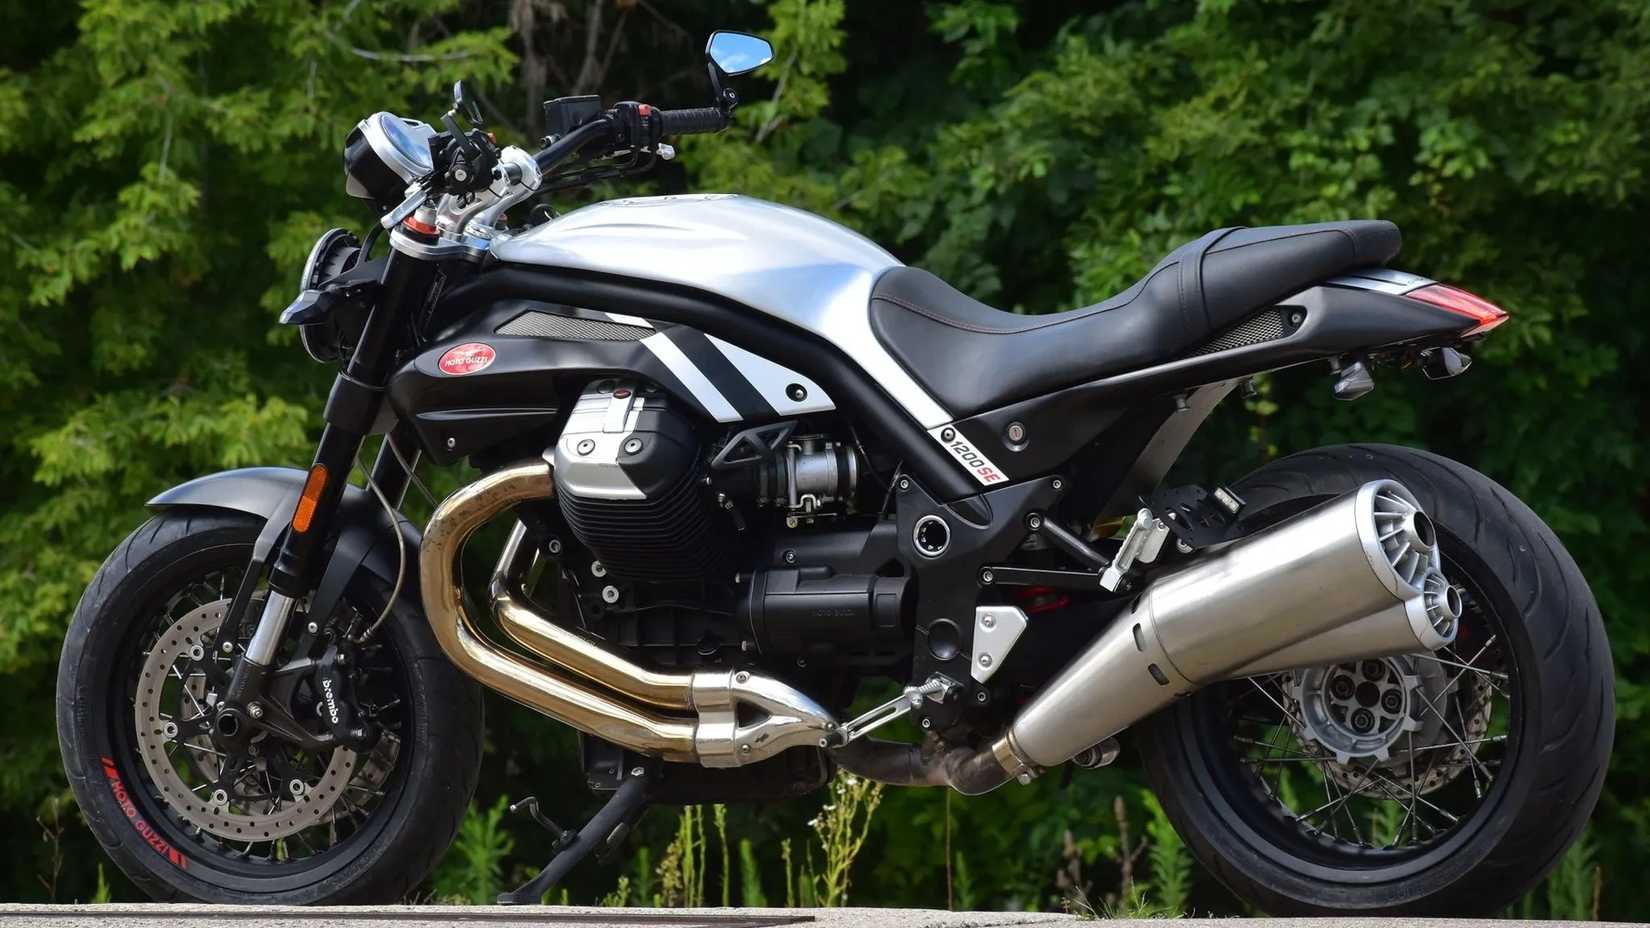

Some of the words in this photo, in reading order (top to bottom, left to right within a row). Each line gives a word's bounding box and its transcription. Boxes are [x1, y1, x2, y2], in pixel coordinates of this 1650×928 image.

[322, 680, 339, 724] brembo
[111, 780, 137, 818] MOTO
[135, 820, 169, 854] GUZZI
